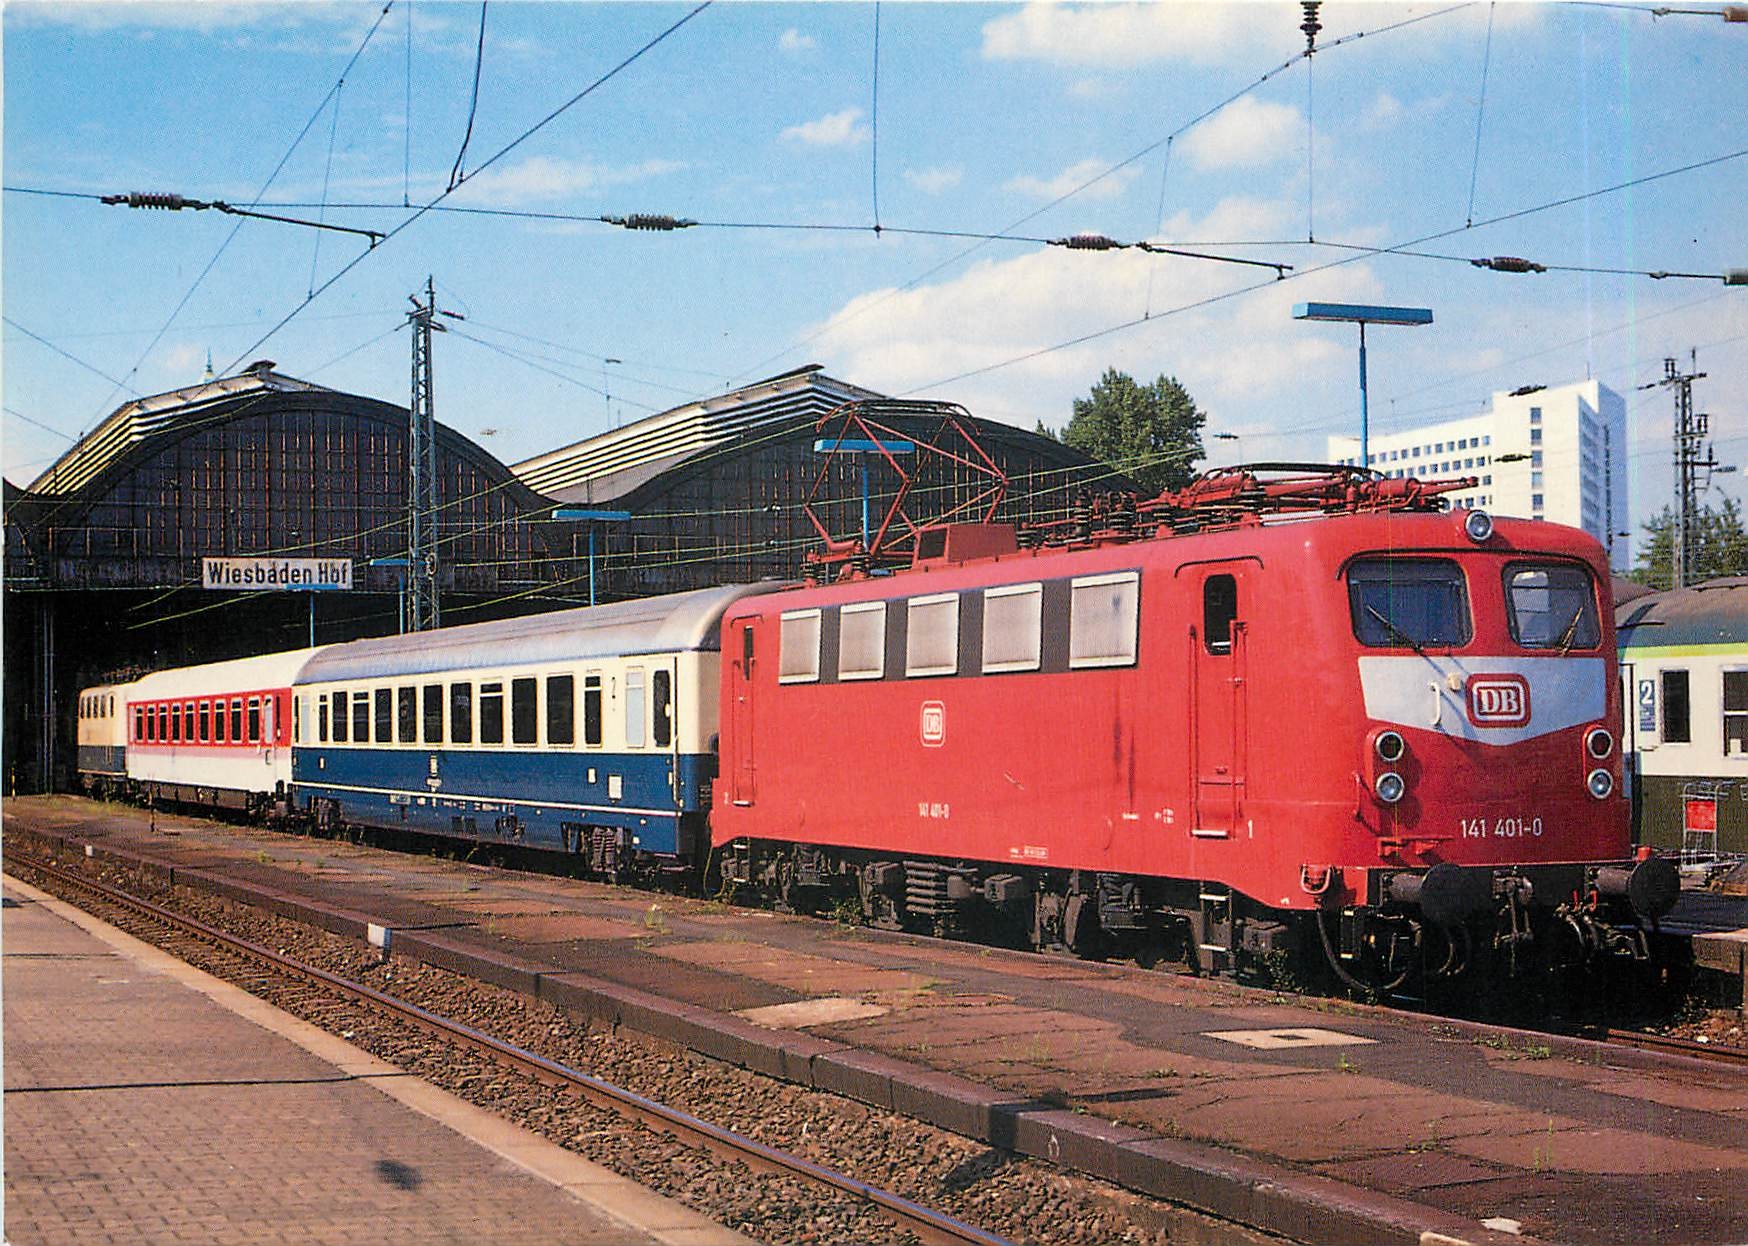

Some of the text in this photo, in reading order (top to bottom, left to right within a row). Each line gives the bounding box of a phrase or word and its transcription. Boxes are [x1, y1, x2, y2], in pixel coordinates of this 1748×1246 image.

[208, 561, 312, 584] Wiesbaden
[1479, 689, 1519, 713] DB
[1641, 681, 1653, 704] 2
[1461, 817, 1543, 838] 141 401-0
